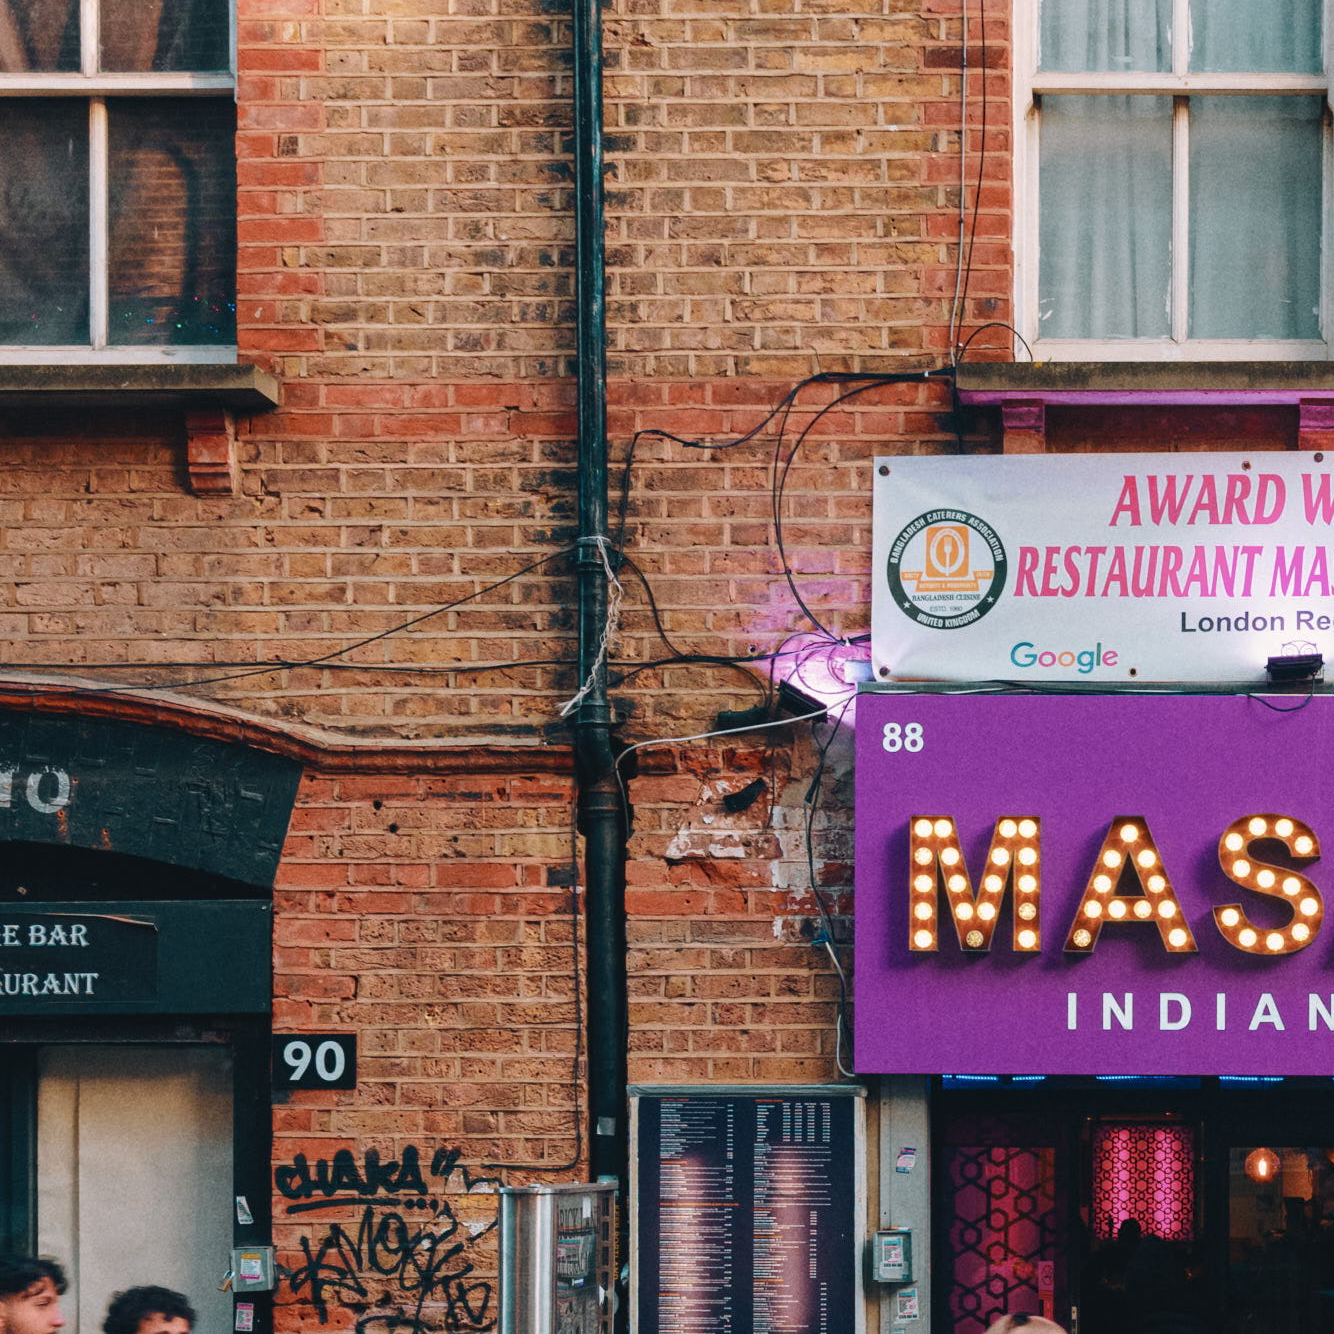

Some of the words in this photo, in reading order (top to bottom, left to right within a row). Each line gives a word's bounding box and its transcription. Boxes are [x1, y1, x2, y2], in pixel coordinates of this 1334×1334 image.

[1109, 474, 1286, 526] AWARD
[890, 517, 926, 564] BANGLADESH
[927, 511, 967, 523] CATERERS
[968, 517, 1004, 562] ASSOCIATION
[1014, 546, 1263, 599] RESTAURANT
[912, 594, 954, 602] BANGLADESH
[917, 612, 944, 627] UNITED
[945, 608, 981, 628] KINGDOM
[1181, 611, 1285, 633] London
[1010, 642, 1118, 673] Google
[881, 723, 924, 753] 88
[29, 924, 90, 948] BAR
[0, 972, 99, 996] URANT
[283, 1041, 346, 1081] 90
